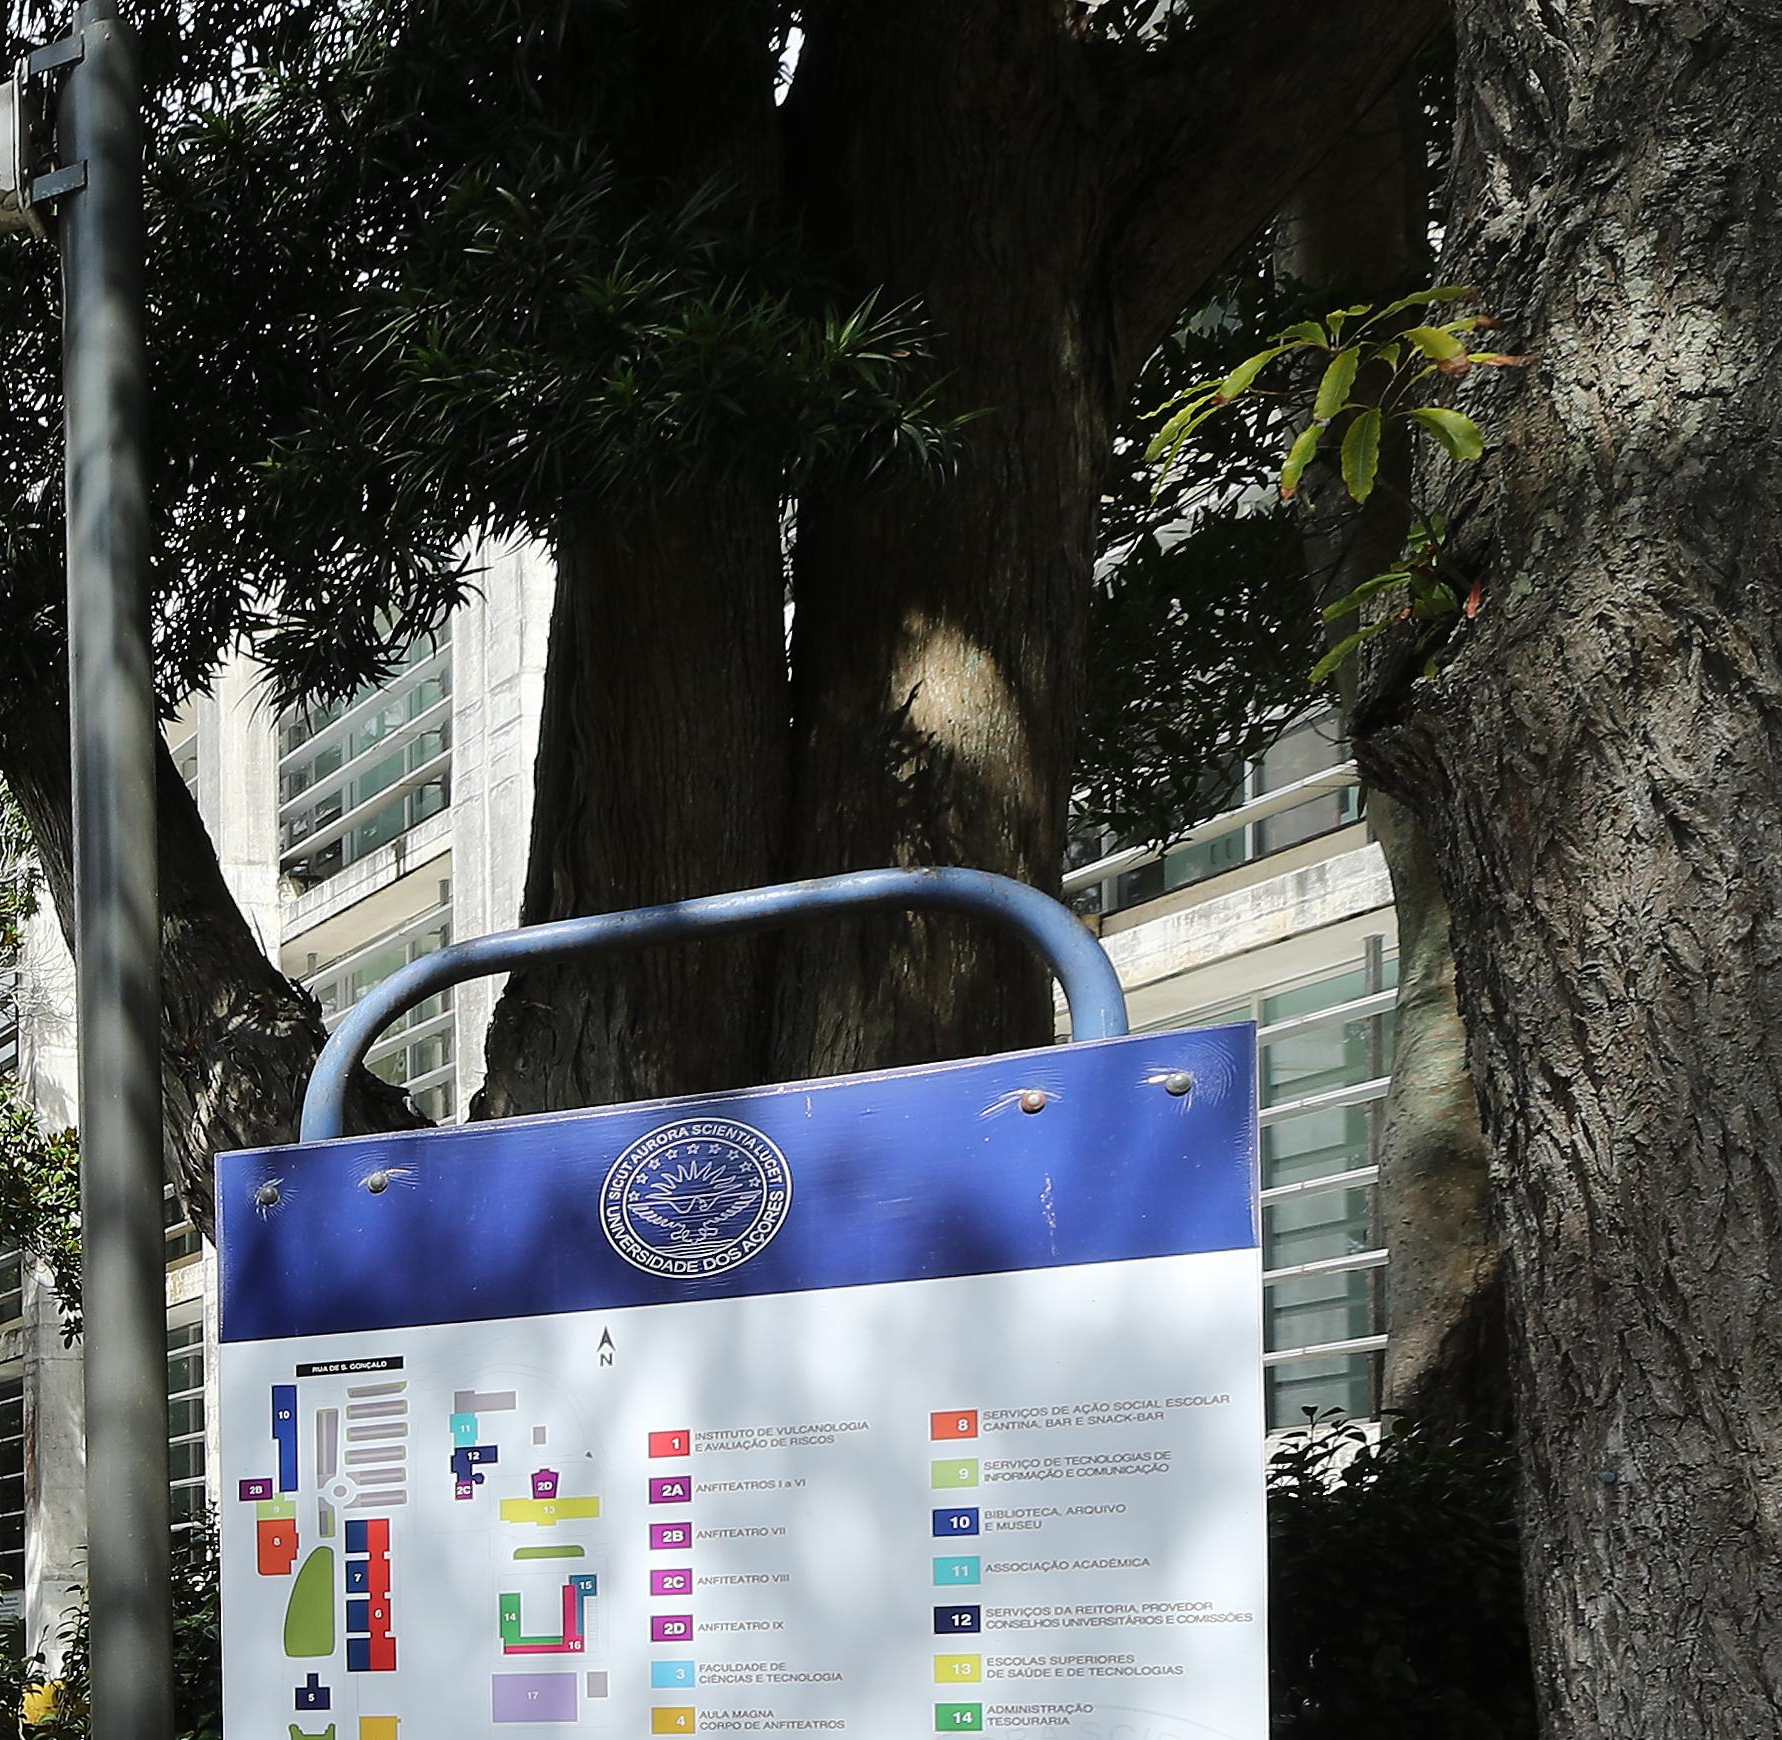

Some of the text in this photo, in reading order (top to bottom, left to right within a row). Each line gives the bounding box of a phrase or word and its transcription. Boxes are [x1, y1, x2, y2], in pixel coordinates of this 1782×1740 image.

[609, 1125, 783, 1199] SICUT AURORA SCIENTIA LUCET
[607, 1190, 784, 1273] UNIVERSIDADE DOS AÇORES
[600, 1353, 612, 1366] N
[983, 1394, 1229, 1421] SERVIÇOS DE AÇÃO SOCIAL ESCOLAR
[278, 1411, 289, 1420] 10
[958, 1419, 968, 1431] 8
[983, 1412, 1164, 1432] CANTINA, BAR E SNACK-BAR
[695, 1421, 869, 1440] INSTITUTO DE VULCANOLOGIA
[672, 1438, 680, 1449] 1
[695, 1435, 835, 1452] E AVALIAÇÃO DE RISCOS
[467, 1451, 480, 1460] 12
[984, 1451, 1171, 1472] SERVIÇO DE TECNOLOGIAS DE
[959, 1469, 968, 1480] 9
[984, 1464, 1169, 1482] INFORMAÇÃO E COMUNICAÇÃO
[249, 1485, 262, 1495] 2B
[538, 1481, 553, 1491] 2D
[662, 1485, 684, 1497] 2A
[696, 1481, 775, 1492] ANFITEATROS
[795, 1479, 805, 1487] VI
[984, 1504, 1126, 1519] BIBLIOTECA, ARQUIVO
[950, 1517, 970, 1529] 10
[985, 1520, 1042, 1531] E MUSEU
[663, 1531, 684, 1543] 2B
[696, 1527, 786, 1539] ANFITEATRO VII
[952, 1565, 969, 1577] 11
[985, 1557, 1150, 1574] ASSOCIAÇÃO ACADÉMICA
[580, 1580, 591, 1590] 15
[663, 1577, 684, 1588] 2C
[697, 1574, 790, 1585] ANFITEATRO VIII
[987, 1602, 1213, 1618] SERVIÇOS DA REITORIA, PROVEDOR
[504, 1612, 516, 1622] 14
[952, 1614, 972, 1627] 12
[987, 1612, 1252, 1629] CONSELHOS UNIVERSITÁRIOS E COMISSÕES
[663, 1623, 685, 1634] 2D
[698, 1621, 784, 1632] ANFITEATRO IX
[568, 1641, 581, 1650] 16
[987, 1655, 1135, 1667] ESCOLAS SUPERIORES
[699, 1663, 786, 1672] FACULDADE DE
[952, 1663, 971, 1675] 13
[987, 1666, 1183, 1679] DE SAÚDE E DE TECNOLOGIAS
[676, 1669, 685, 1679] 3
[699, 1672, 843, 1684] CIÊNCIAS E TECNOLOGIA
[527, 1691, 539, 1700] 17
[699, 1711, 728, 1719] AULA
[987, 1703, 1093, 1715] ADMINISTRAÇÃO
[676, 1715, 685, 1726] 4
[952, 1713, 972, 1724] 14
[988, 1717, 1070, 1726] TESOURARIA
[699, 1720, 845, 1731] CORPO DE ANFITEATROS
